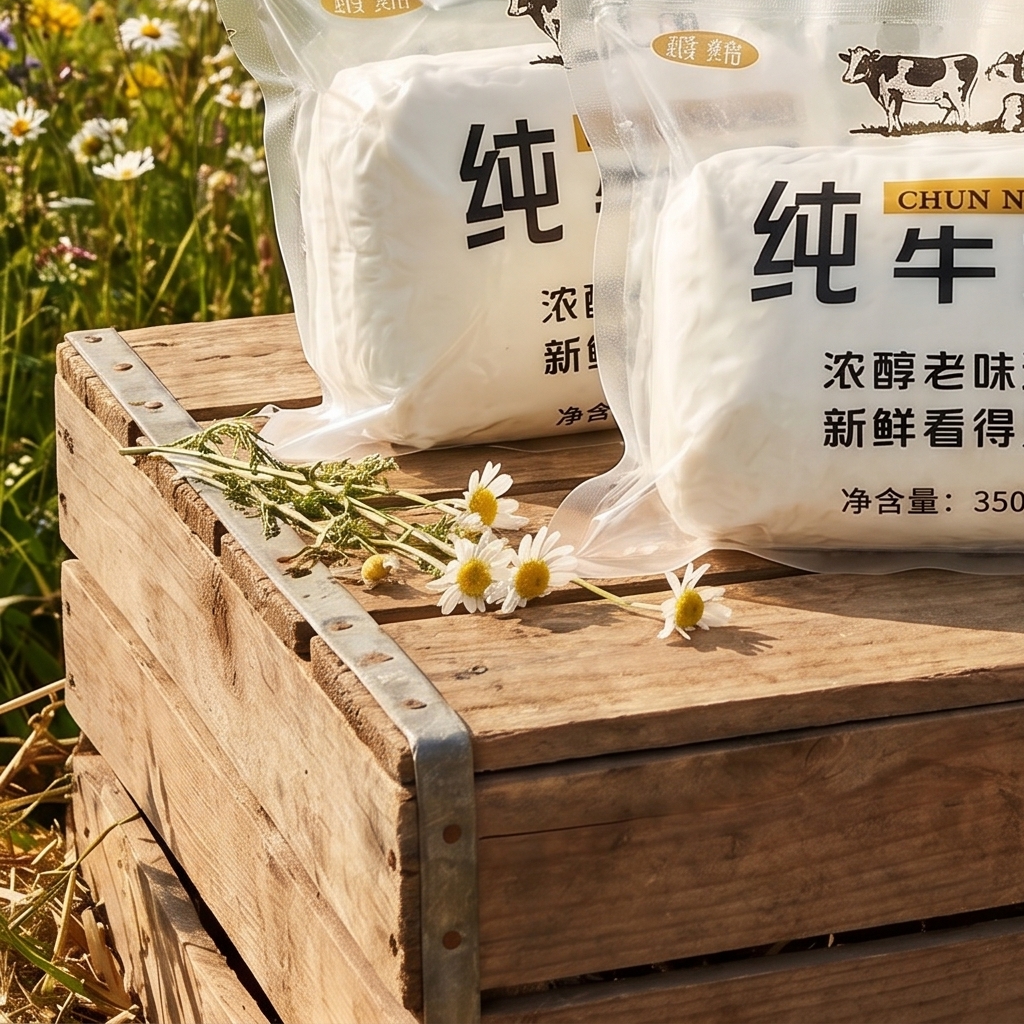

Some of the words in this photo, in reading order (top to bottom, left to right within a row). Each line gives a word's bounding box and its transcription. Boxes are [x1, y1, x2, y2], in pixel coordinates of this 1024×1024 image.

[460, 118, 602, 249] 纯
[898, 188, 990, 211] CHUN
[541, 284, 594, 324] 浓
